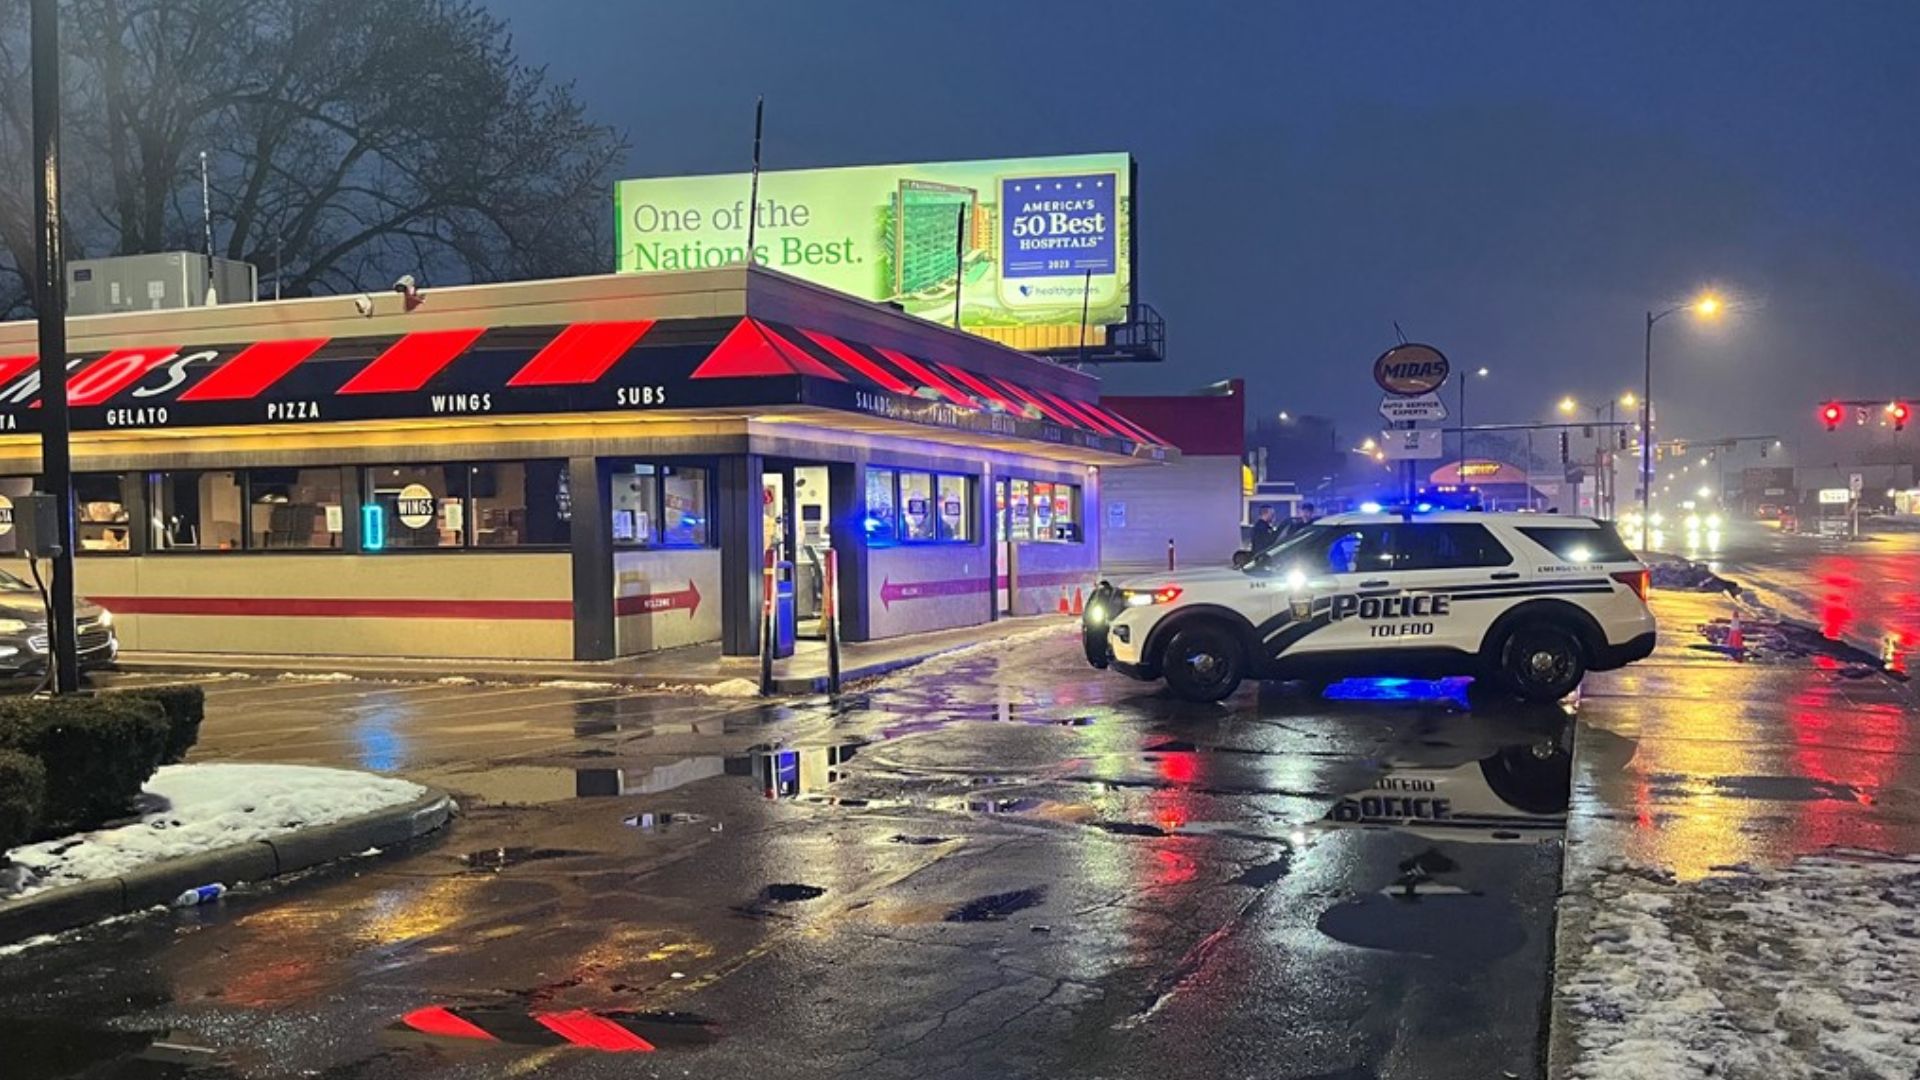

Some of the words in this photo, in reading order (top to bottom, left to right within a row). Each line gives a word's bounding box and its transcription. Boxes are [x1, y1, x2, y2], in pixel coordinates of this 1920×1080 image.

[1022, 199, 1095, 213] AMERICA'S
[634, 204, 701, 233] One
[712, 201, 743, 230] of
[757, 199, 810, 229] the
[1012, 215, 1046, 237] 50
[1048, 212, 1106, 235] Best
[634, 241, 769, 271] Nations
[780, 236, 863, 266] Best.
[1382, 362, 1445, 380] MIDAS
[431, 393, 491, 412] WINGS
[617, 386, 665, 405] SUBS
[107, 408, 168, 425] GELATO
[268, 403, 320, 420] PIZZA
[398, 501, 434, 514] WINGS
[1331, 594, 1450, 621] POLICE
[1370, 622, 1434, 637] TOLEDO
